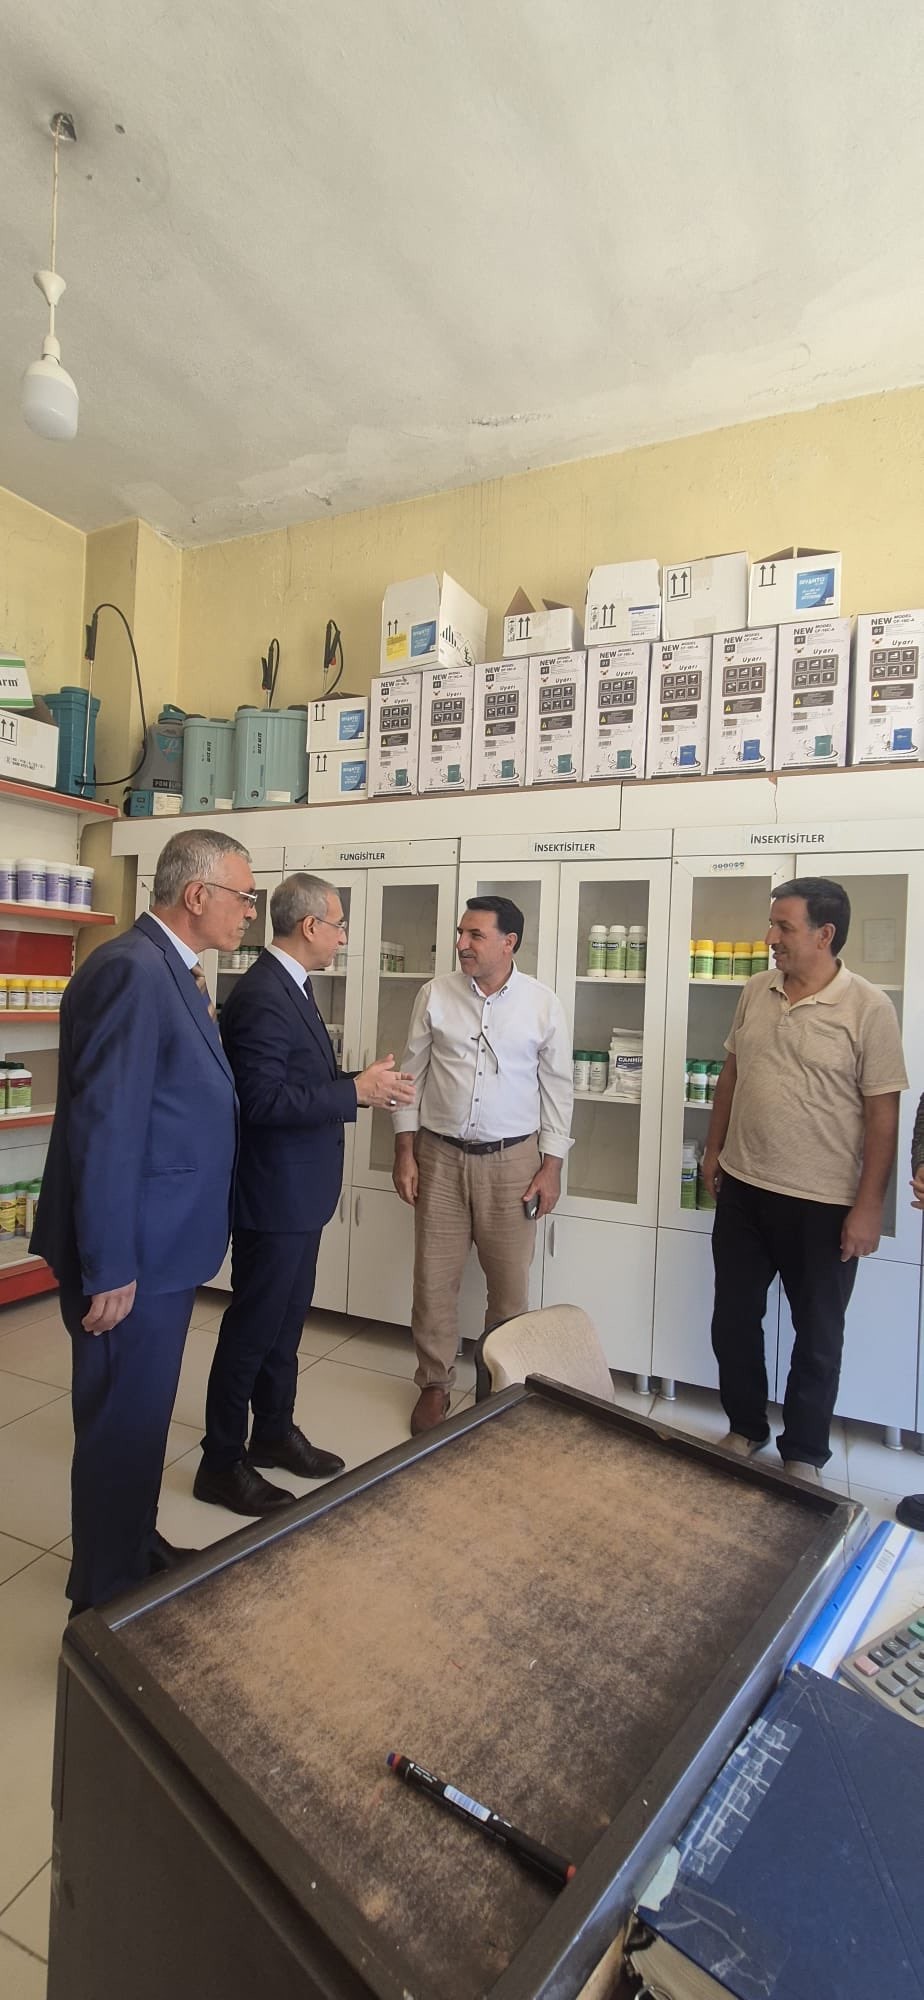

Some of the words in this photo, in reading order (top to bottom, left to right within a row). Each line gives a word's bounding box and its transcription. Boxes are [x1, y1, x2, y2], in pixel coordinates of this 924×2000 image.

[871, 617, 893, 625] NEW
[793, 627, 814, 635] NEW
[724, 636, 743, 644] NEW
[661, 644, 680, 652] NEW
[599, 651, 616, 659] NEW
[750, 833, 825, 844] İNSEKTİSİTLER
[534, 842, 595, 852] İNSEKTİSİTLER
[340, 851, 385, 861] FUNGİSİTLER
